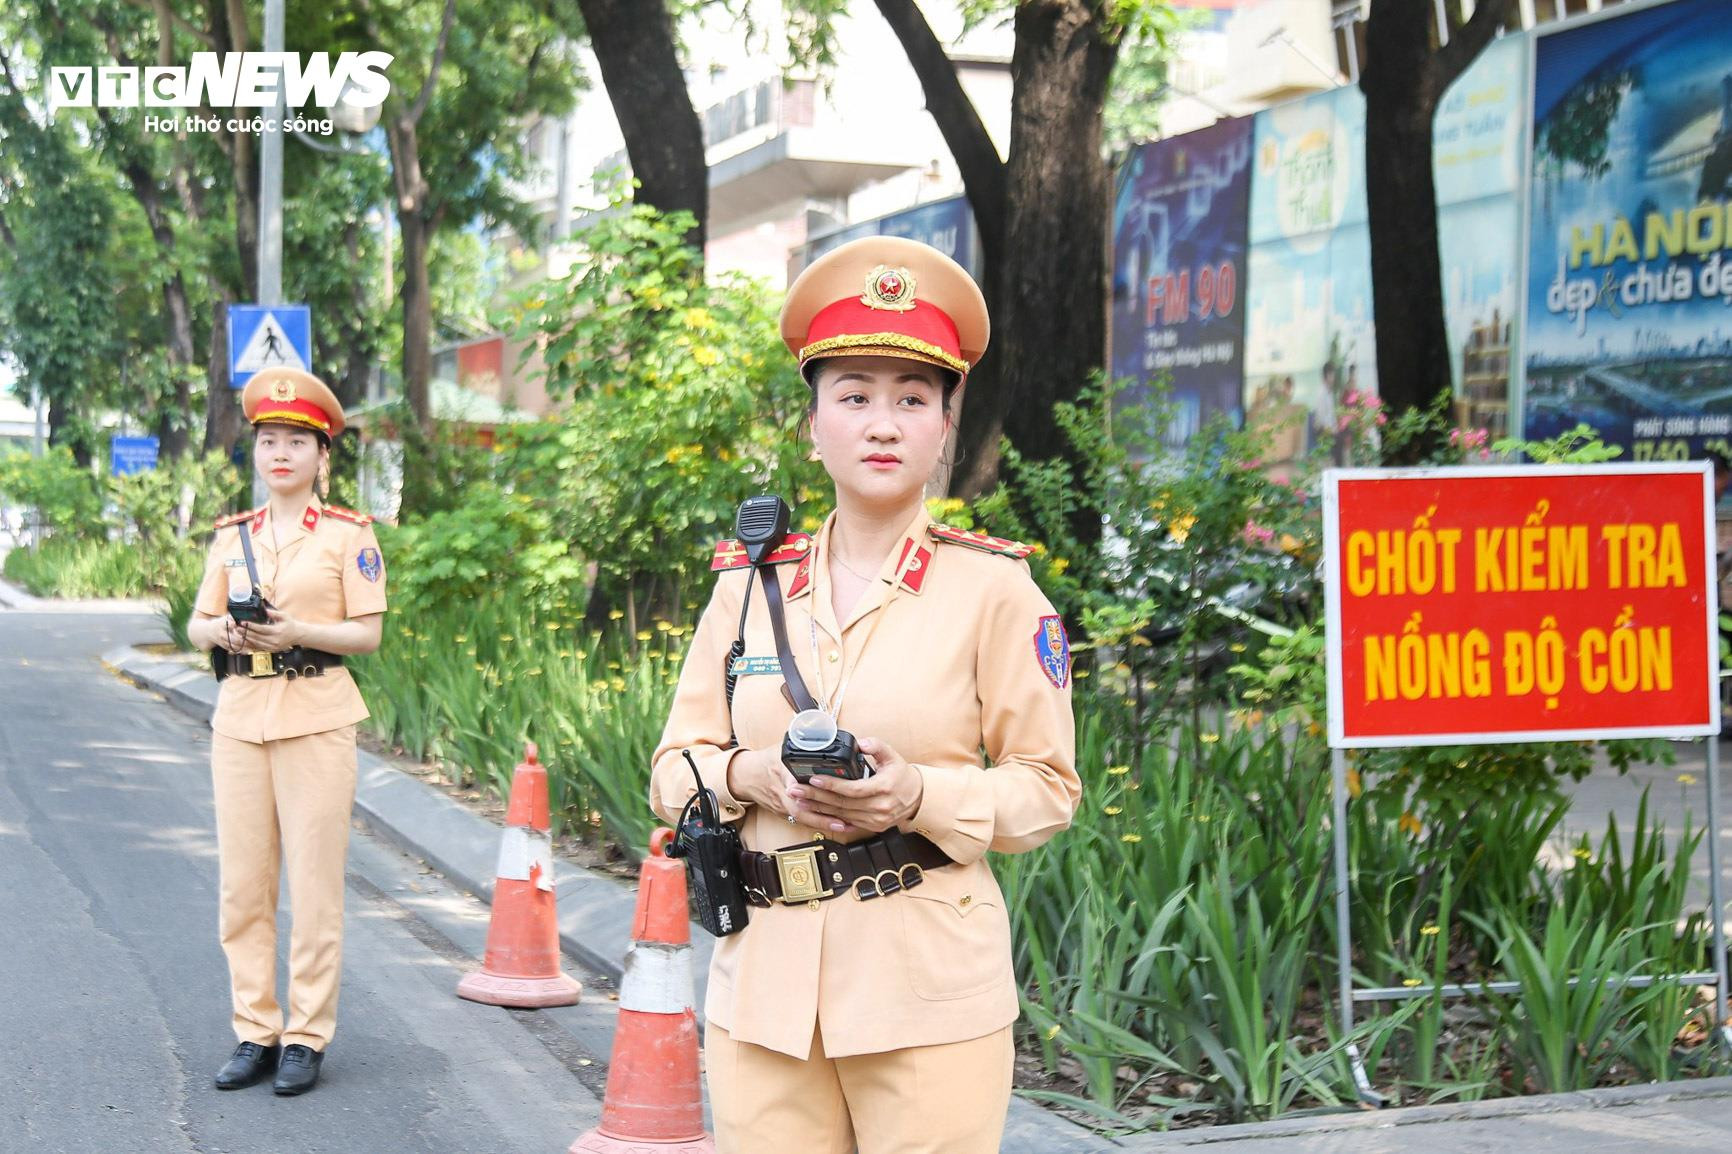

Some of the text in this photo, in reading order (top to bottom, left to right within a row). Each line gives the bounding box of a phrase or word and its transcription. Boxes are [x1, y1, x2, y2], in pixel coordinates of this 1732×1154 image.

[1146, 262, 1236, 327] FM 90
[1547, 251, 1598, 337] đẹp
[1620, 261, 1693, 306] chưa
[1699, 252, 1732, 306] đẹ
[1345, 499, 1687, 597] CHỐT KIỂM TRA
[1363, 605, 1673, 710] NỒNG ĐỘ CỒN
